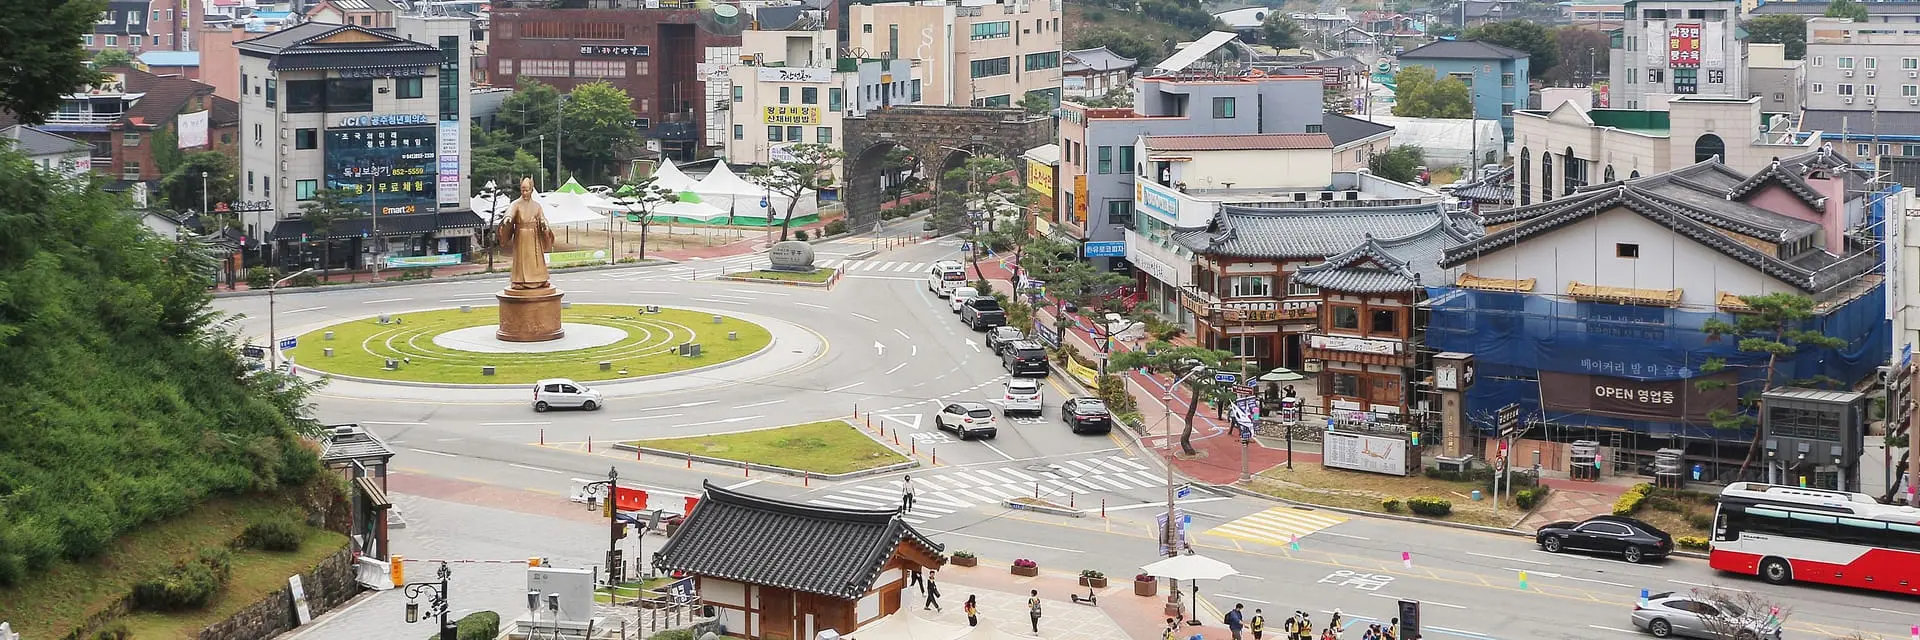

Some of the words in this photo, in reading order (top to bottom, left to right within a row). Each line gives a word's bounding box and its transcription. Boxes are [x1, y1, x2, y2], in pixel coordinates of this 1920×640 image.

[1671, 28, 1699, 38] 짜장면
[1671, 51, 1699, 60] 탕수육
[767, 107, 809, 115] 왕갈비탕
[340, 117, 359, 127] JCI
[371, 115, 427, 126] 공주청년회의소
[392, 168, 424, 176] 852-5559
[382, 205, 416, 215] emart24
[1581, 359, 1625, 374] 베이커리
[1595, 385, 1633, 400] OPEN
[1637, 390, 1675, 404] 영업중
